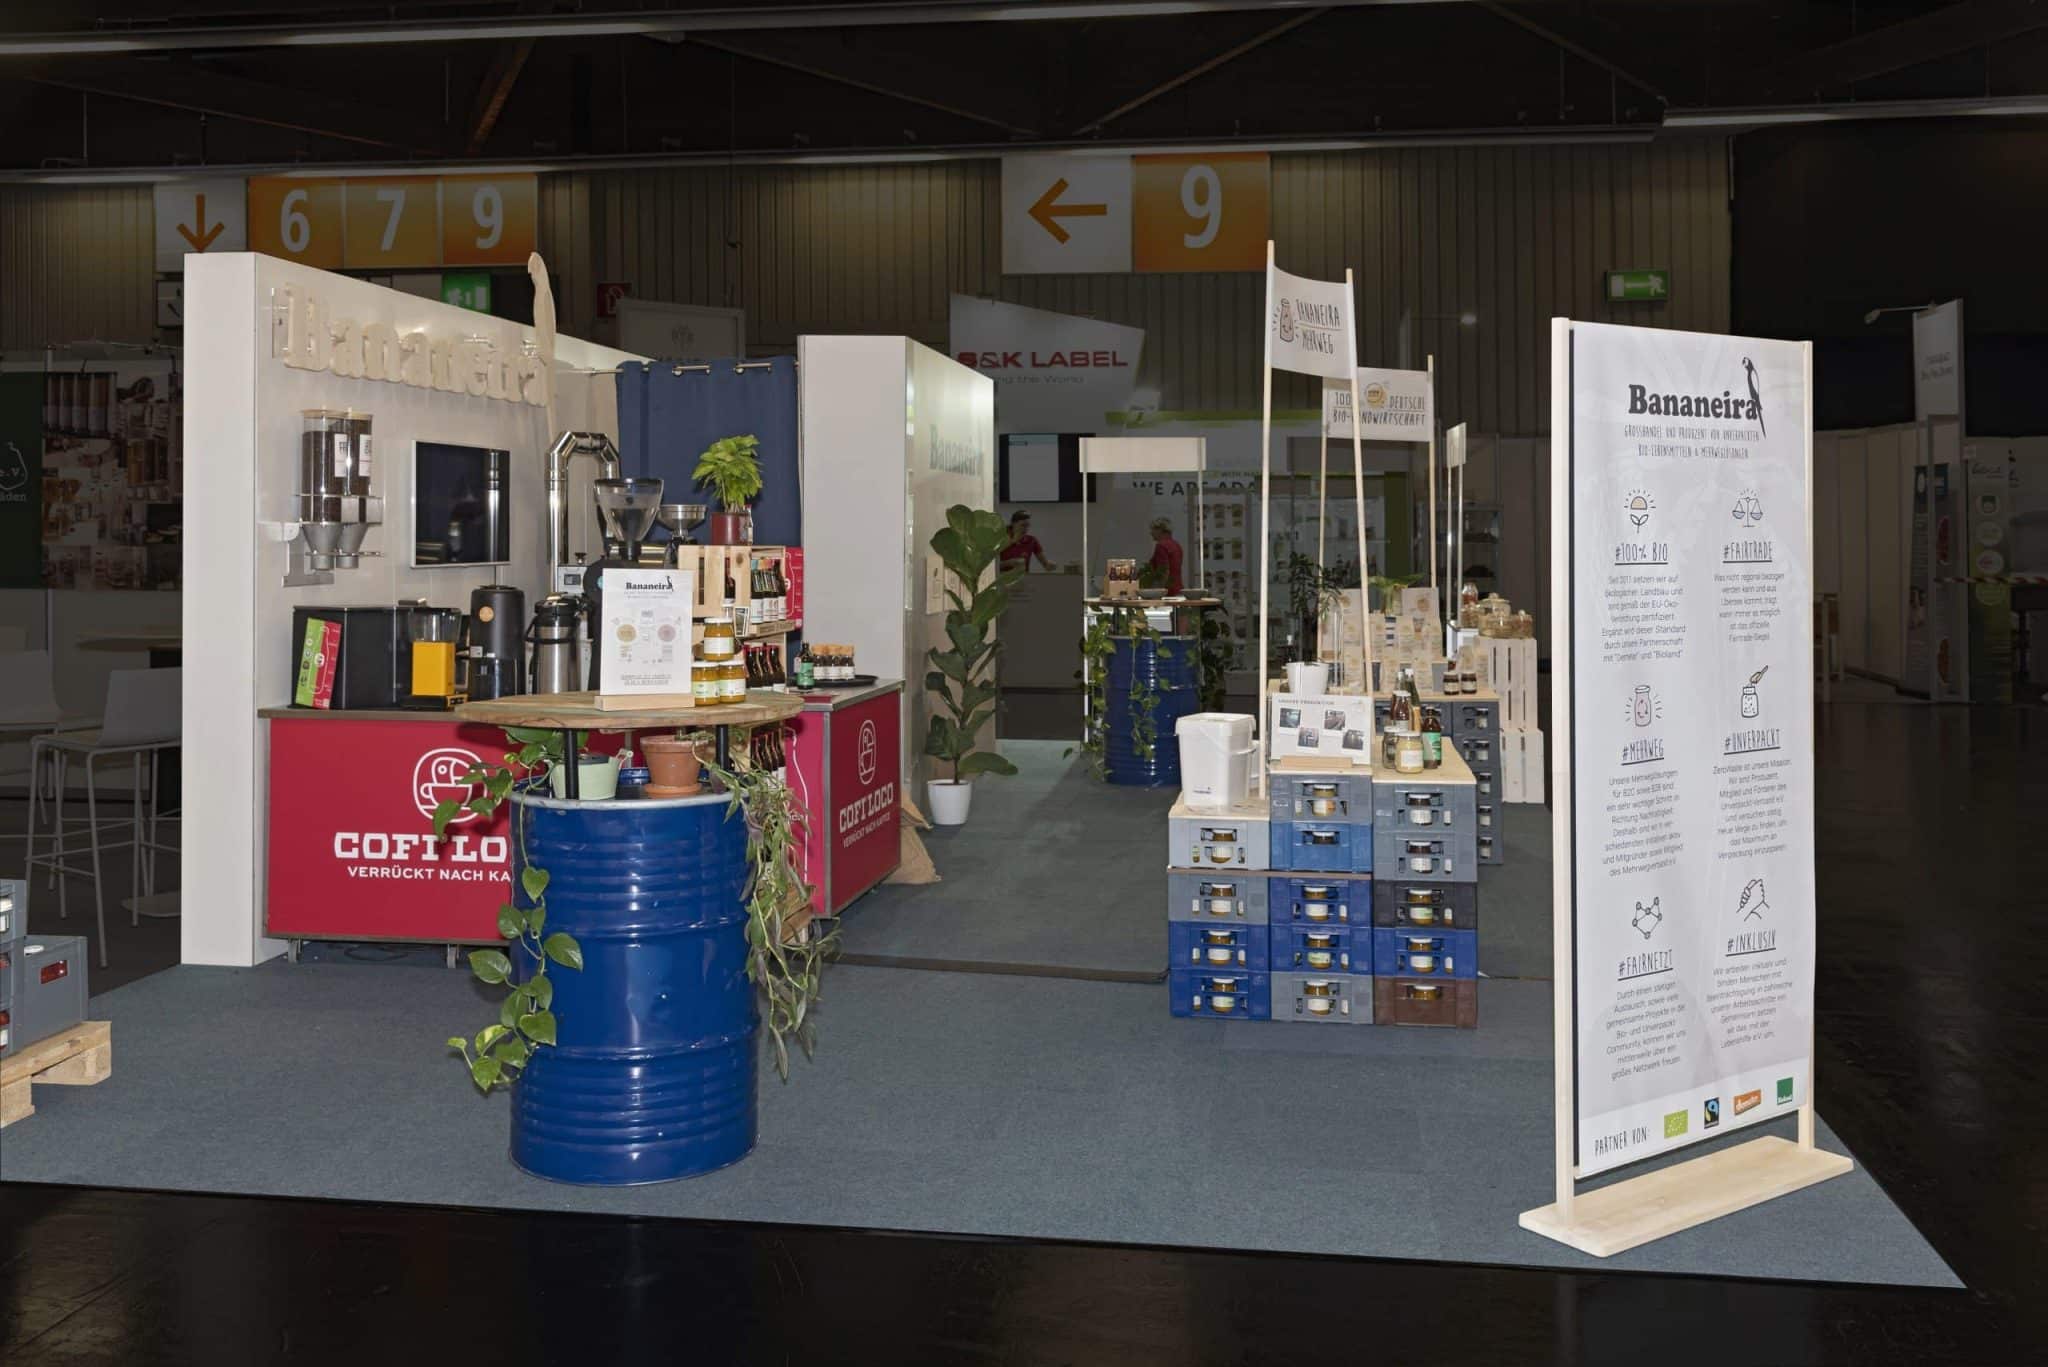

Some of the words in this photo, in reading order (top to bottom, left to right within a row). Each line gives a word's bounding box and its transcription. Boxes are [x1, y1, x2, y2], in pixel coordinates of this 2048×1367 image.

[280, 190, 311, 253] 6
[376, 190, 407, 252] 7
[471, 187, 502, 250] 9
[1180, 165, 1222, 249] 9
[1031, 351, 1128, 368] LABEL
[1628, 384, 1757, 420] Bananeira
[334, 831, 439, 861] COFI
[451, 835, 507, 863] LO
[347, 864, 435, 880] VERRÜCKT
[439, 868, 483, 881] NACH
[489, 870, 511, 882] KA
[1594, 1132, 1628, 1157] PARTNER
